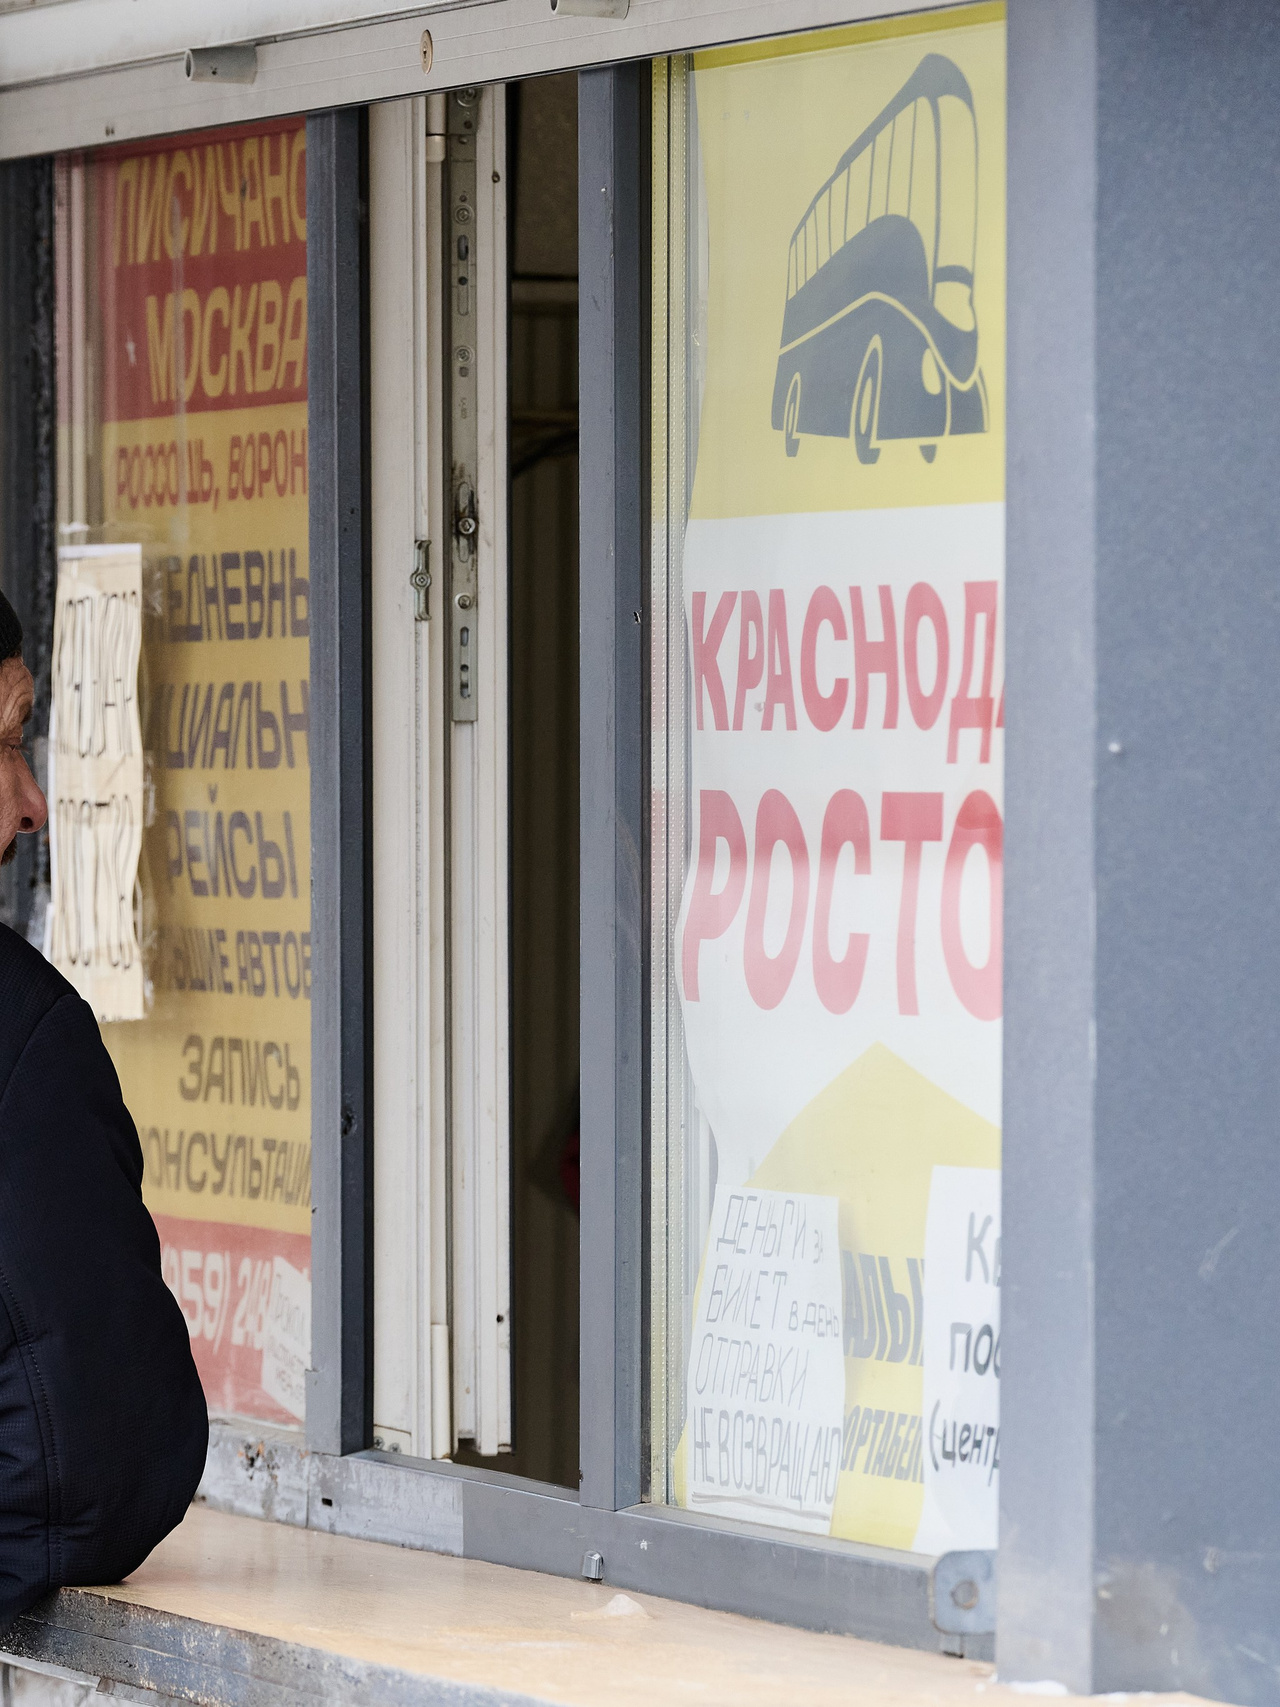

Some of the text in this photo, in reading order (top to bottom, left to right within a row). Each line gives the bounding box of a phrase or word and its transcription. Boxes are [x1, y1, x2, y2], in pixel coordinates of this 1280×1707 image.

[145, 276, 308, 405] МОСКВА
[691, 580, 1004, 764] КРАСНОД
[166, 783, 299, 900] РЕЙСЫ
[682, 788, 1003, 1022] РОСТО
[178, 1034, 301, 1113] ЗАПИСЬ
[143, 1126, 311, 1208] ОНСУЛЬТАЦИ
[716, 1194, 807, 1260] ДЕНЬГИ
[706, 1264, 788, 1330] БИЛЕТ
[695, 1332, 809, 1411] ОТПРАВКИ
[693, 1406, 841, 1510] НЕ ВОЗВРАЩАЮ
